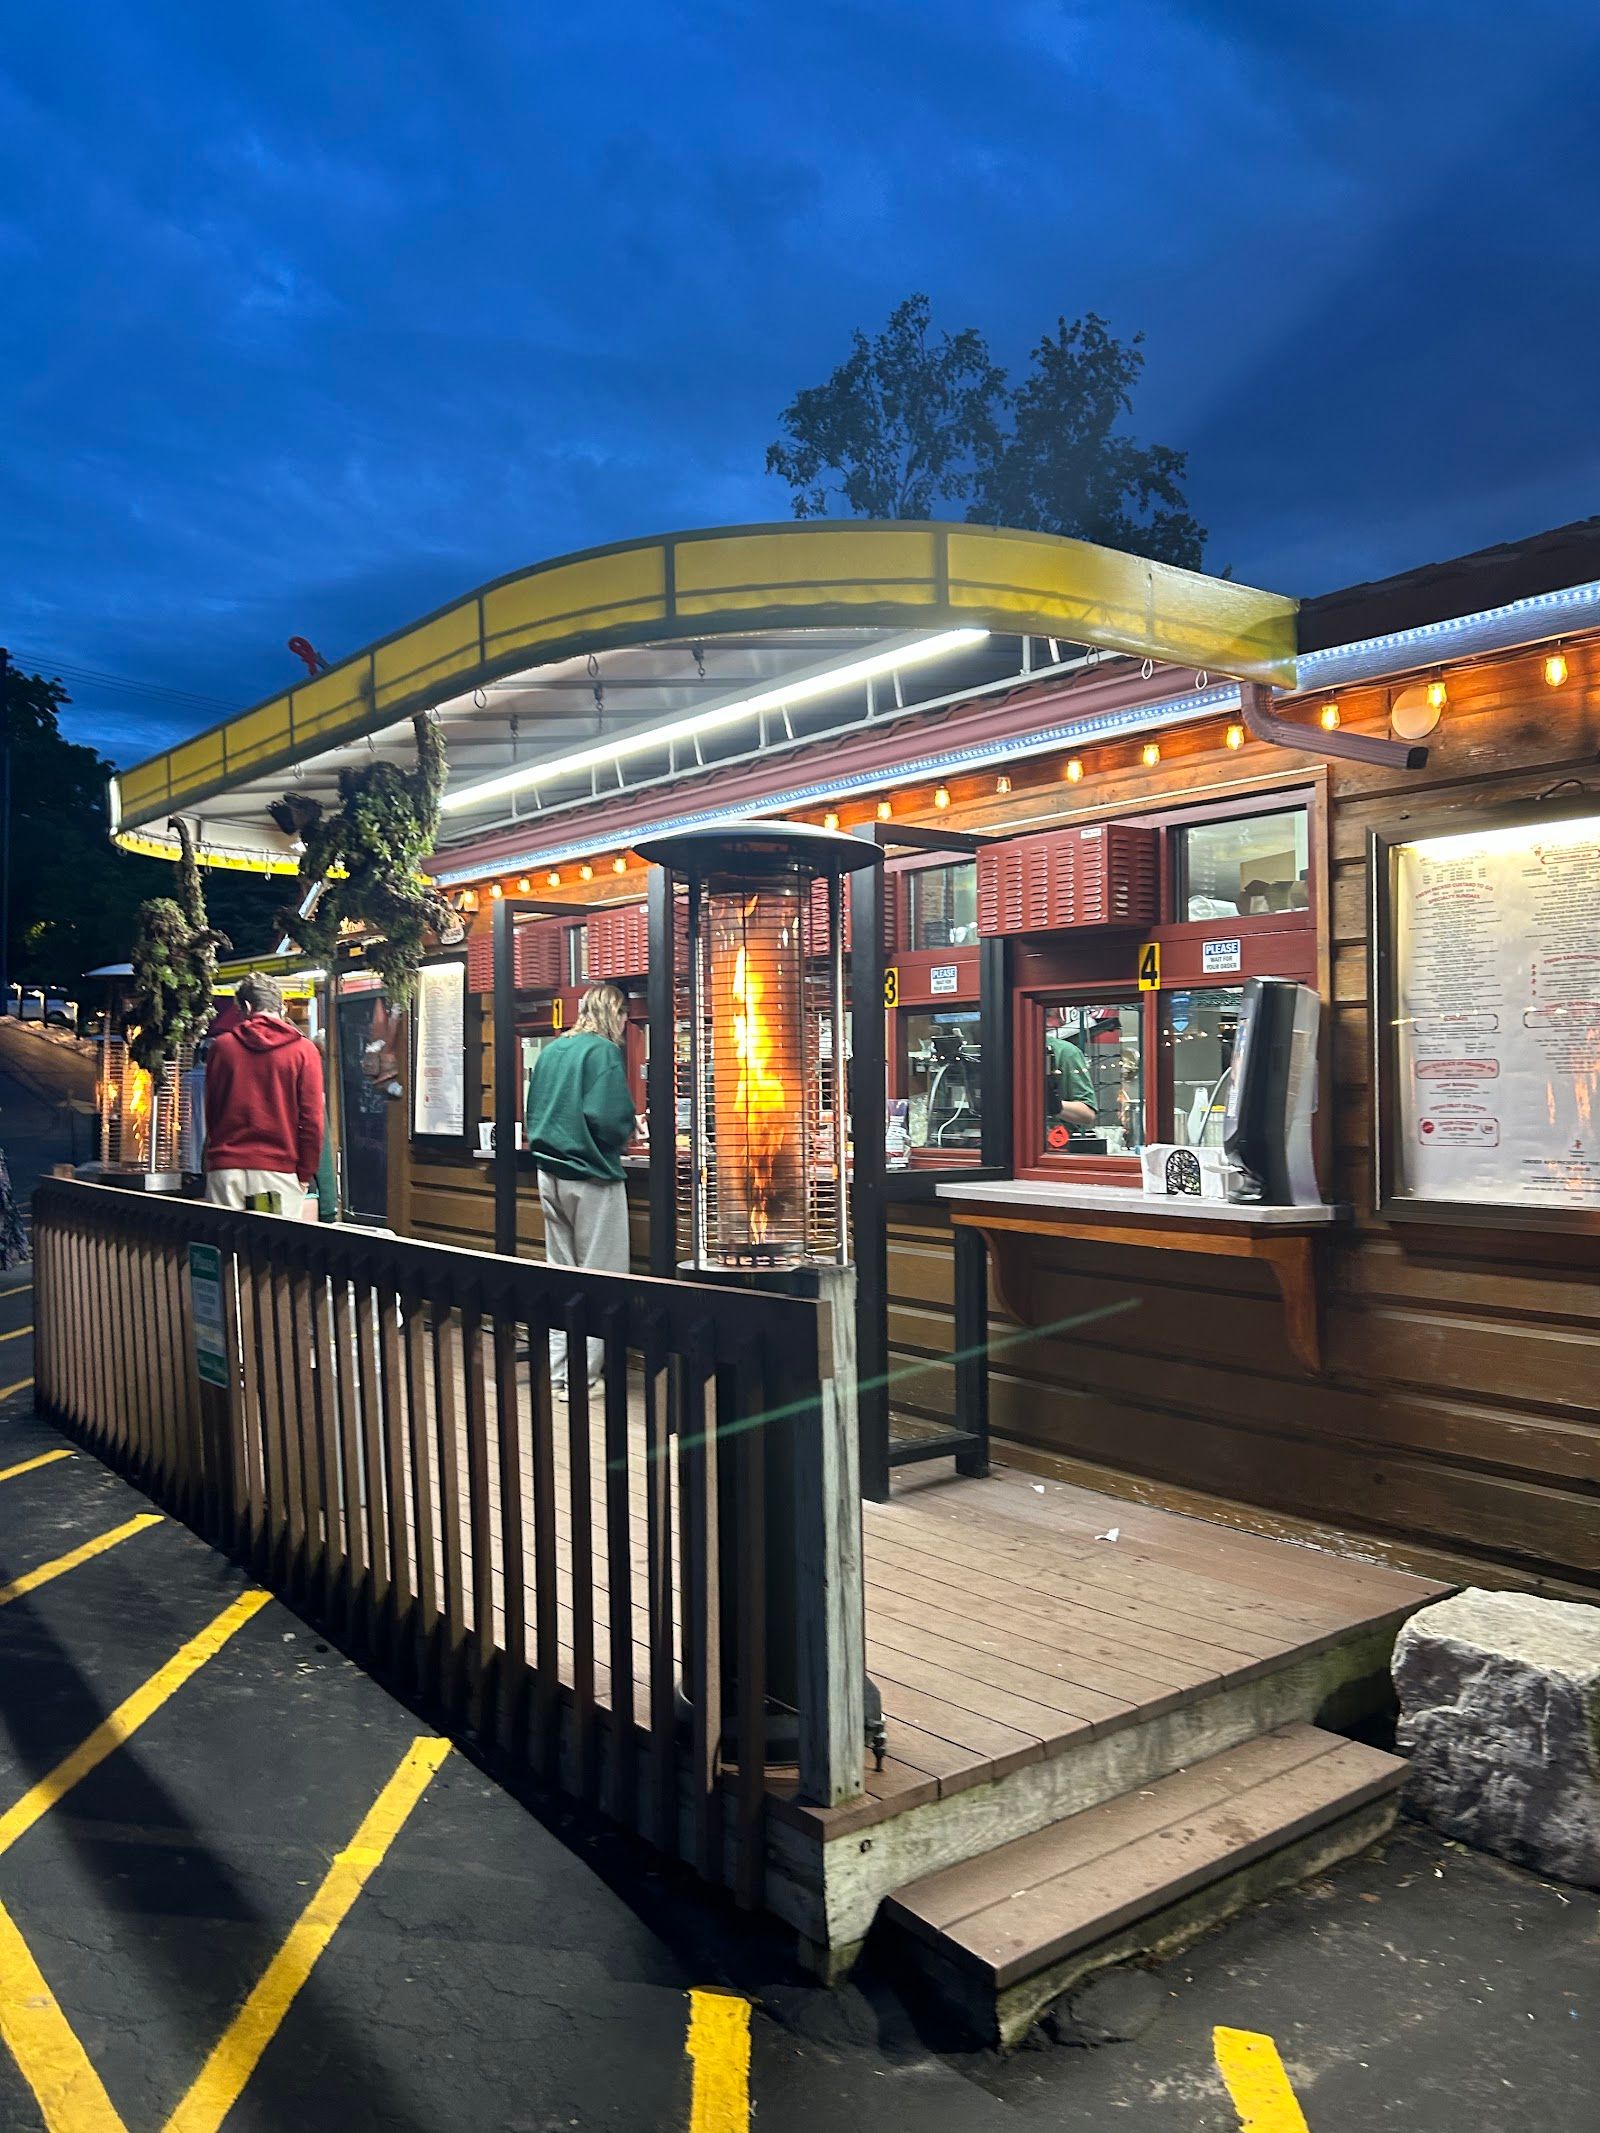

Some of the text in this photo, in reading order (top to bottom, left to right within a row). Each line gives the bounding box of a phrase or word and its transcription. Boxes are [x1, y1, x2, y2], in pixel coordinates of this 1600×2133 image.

[1206, 943, 1238, 954] PLEASE
[933, 969, 955, 978] PLEASE
[1141, 945, 1158, 987] 4
[884, 970, 896, 1005] 3
